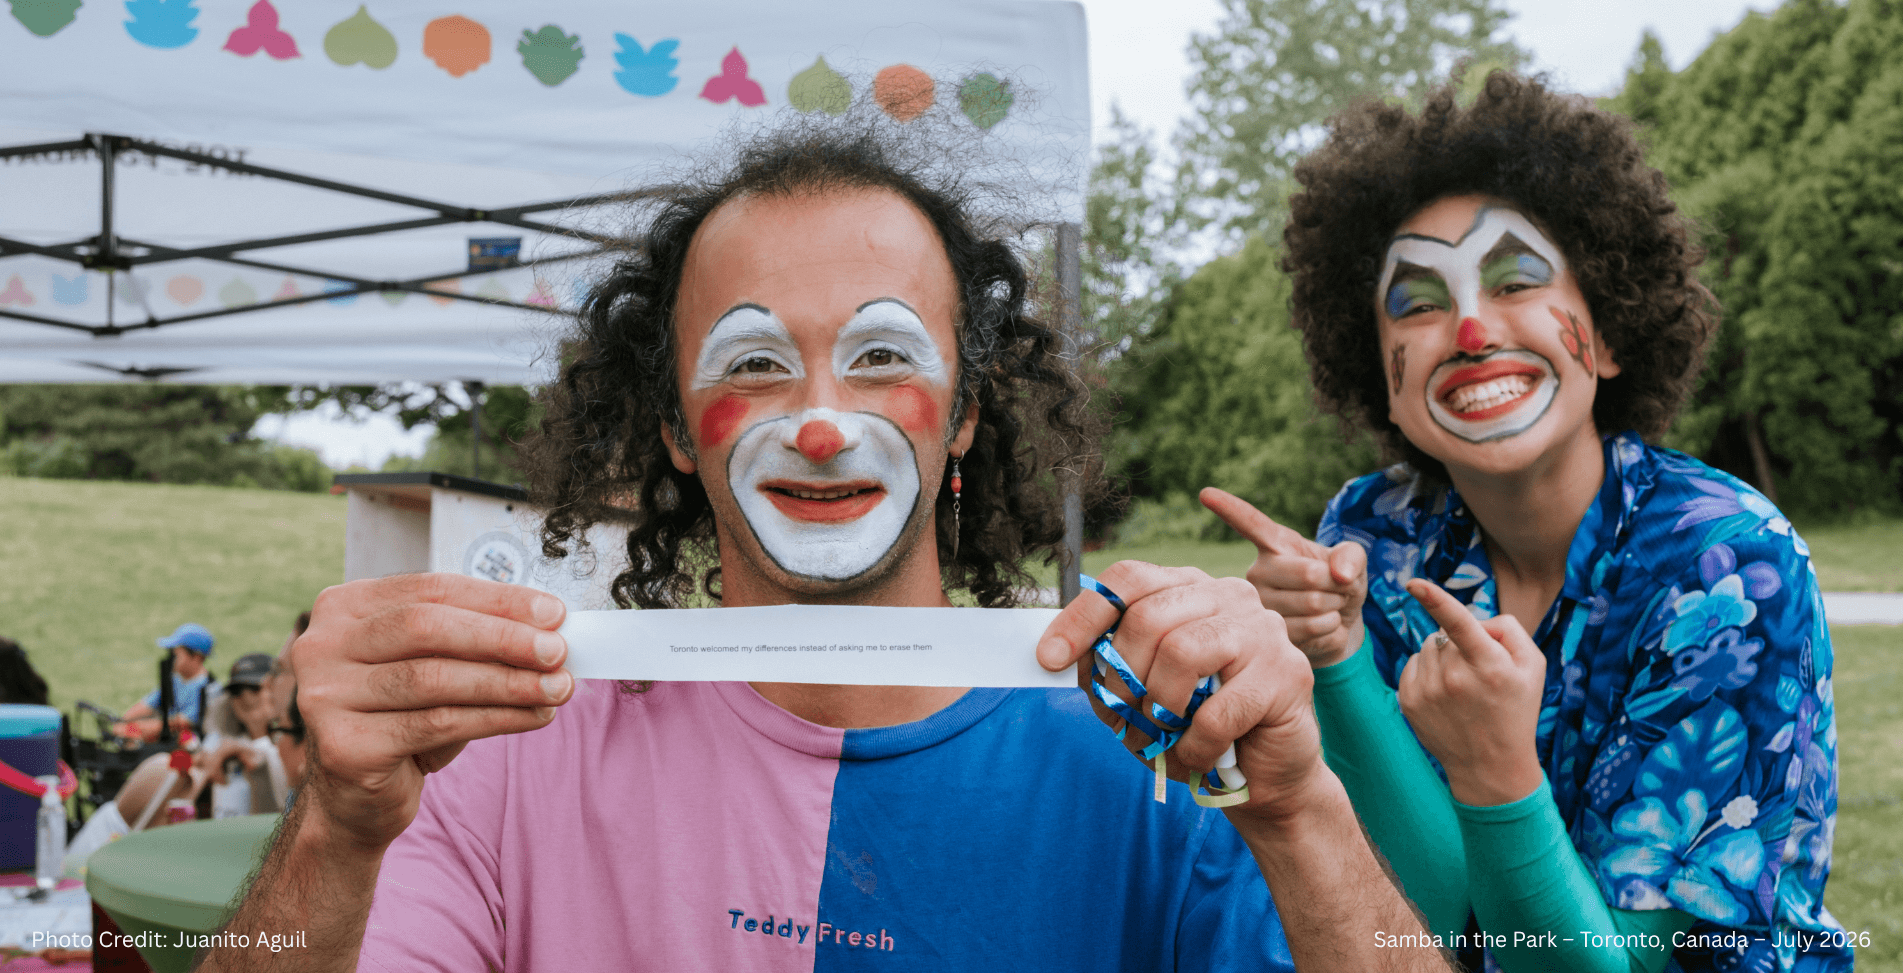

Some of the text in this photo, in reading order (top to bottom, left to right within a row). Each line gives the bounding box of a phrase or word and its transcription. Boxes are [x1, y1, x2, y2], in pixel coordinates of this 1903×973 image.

[669, 645, 699, 653] Toronto
[700, 645, 739, 653] welcomed
[741, 646, 754, 654] my
[755, 644, 798, 653] differences
[799, 644, 827, 652] instead
[829, 643, 837, 652] of
[838, 643, 864, 653] asking
[913, 643, 933, 651] them
[728, 909, 894, 951] Teddy Fresh
